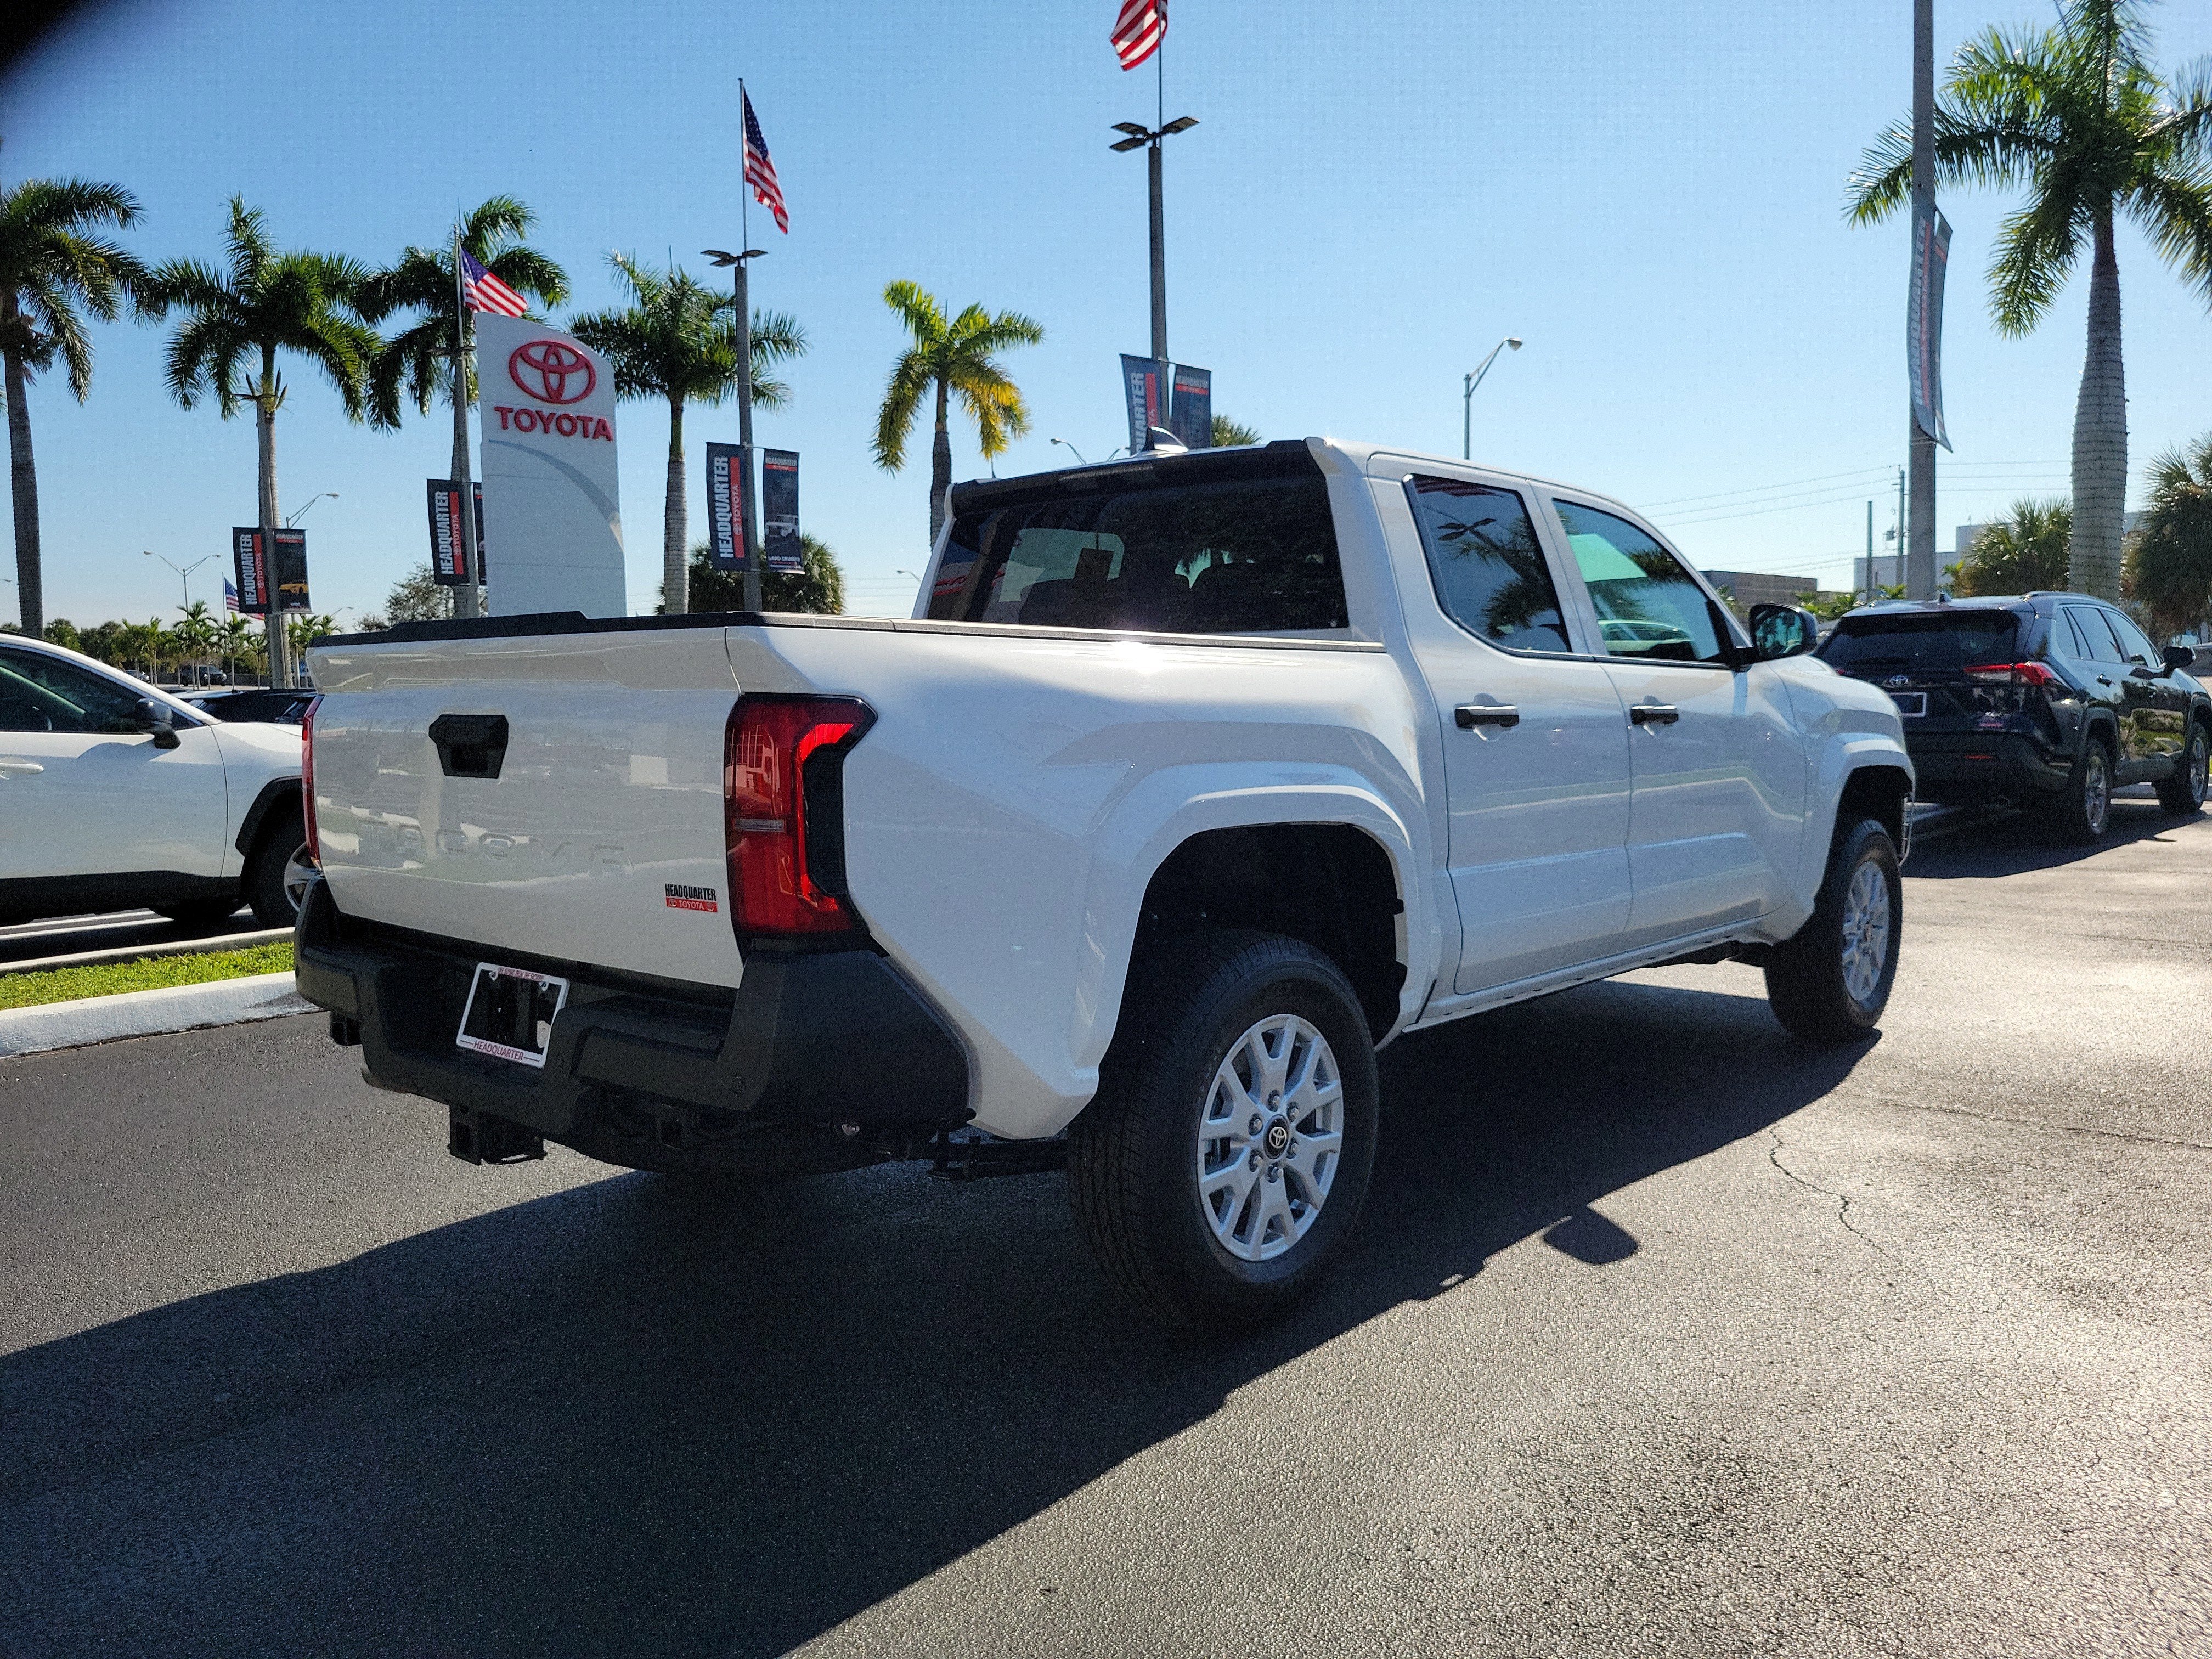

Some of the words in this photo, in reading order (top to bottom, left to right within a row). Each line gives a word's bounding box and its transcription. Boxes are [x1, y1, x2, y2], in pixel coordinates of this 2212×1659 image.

[494, 406, 613, 441] TOYOTA
[714, 456, 734, 558] HEADQUARTER
[732, 484, 742, 522] TOYOTA
[435, 491, 454, 574] HEADQUARTER
[452, 514, 461, 545] TOYOTA
[240, 534, 258, 605] HEADQUARTER
[256, 553, 264, 579] TOYOTA
[665, 884, 716, 901] HEADQUARTER
[678, 900, 704, 910] TOYOTA
[473, 1040, 524, 1061] HEADQUARTER
